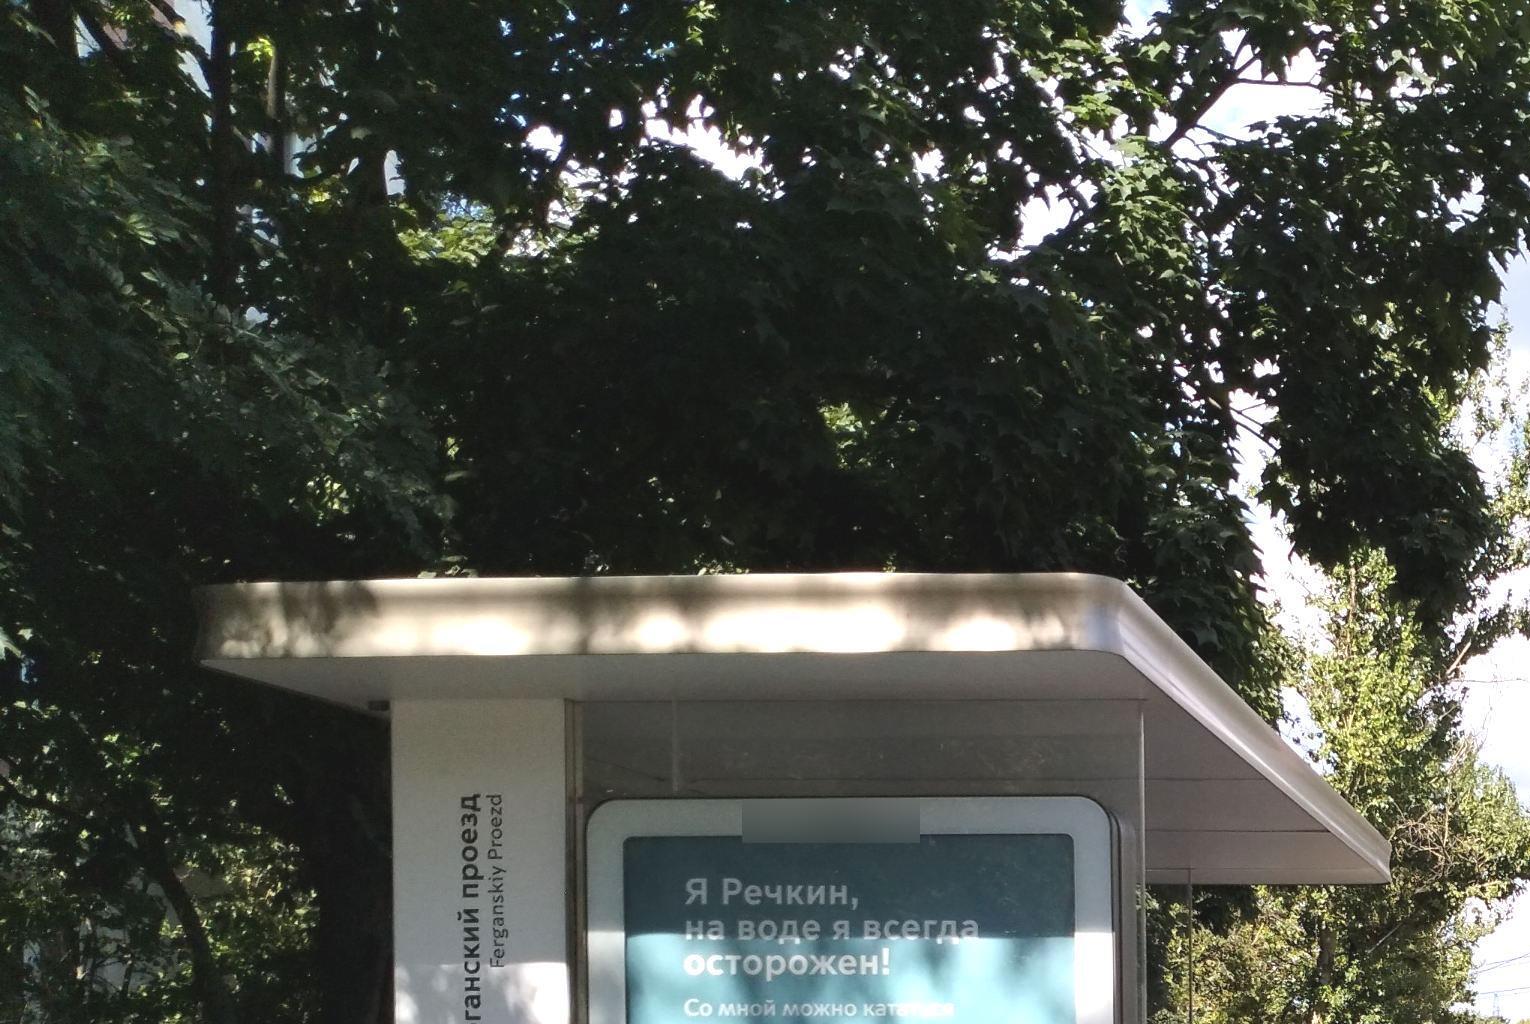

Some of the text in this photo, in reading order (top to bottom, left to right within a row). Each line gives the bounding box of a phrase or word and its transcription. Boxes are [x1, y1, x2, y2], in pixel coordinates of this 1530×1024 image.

[460, 793, 485, 898] проезд
[486, 793, 509, 968] Ferganskiy Proezd
[685, 878, 859, 910] Я Речкин,
[685, 919, 980, 945] на воде я всегда
[683, 948, 890, 981] осторожен!
[684, 998, 713, 1017] Со
[718, 999, 776, 1017] мной
[782, 1002, 857, 1017] можно
